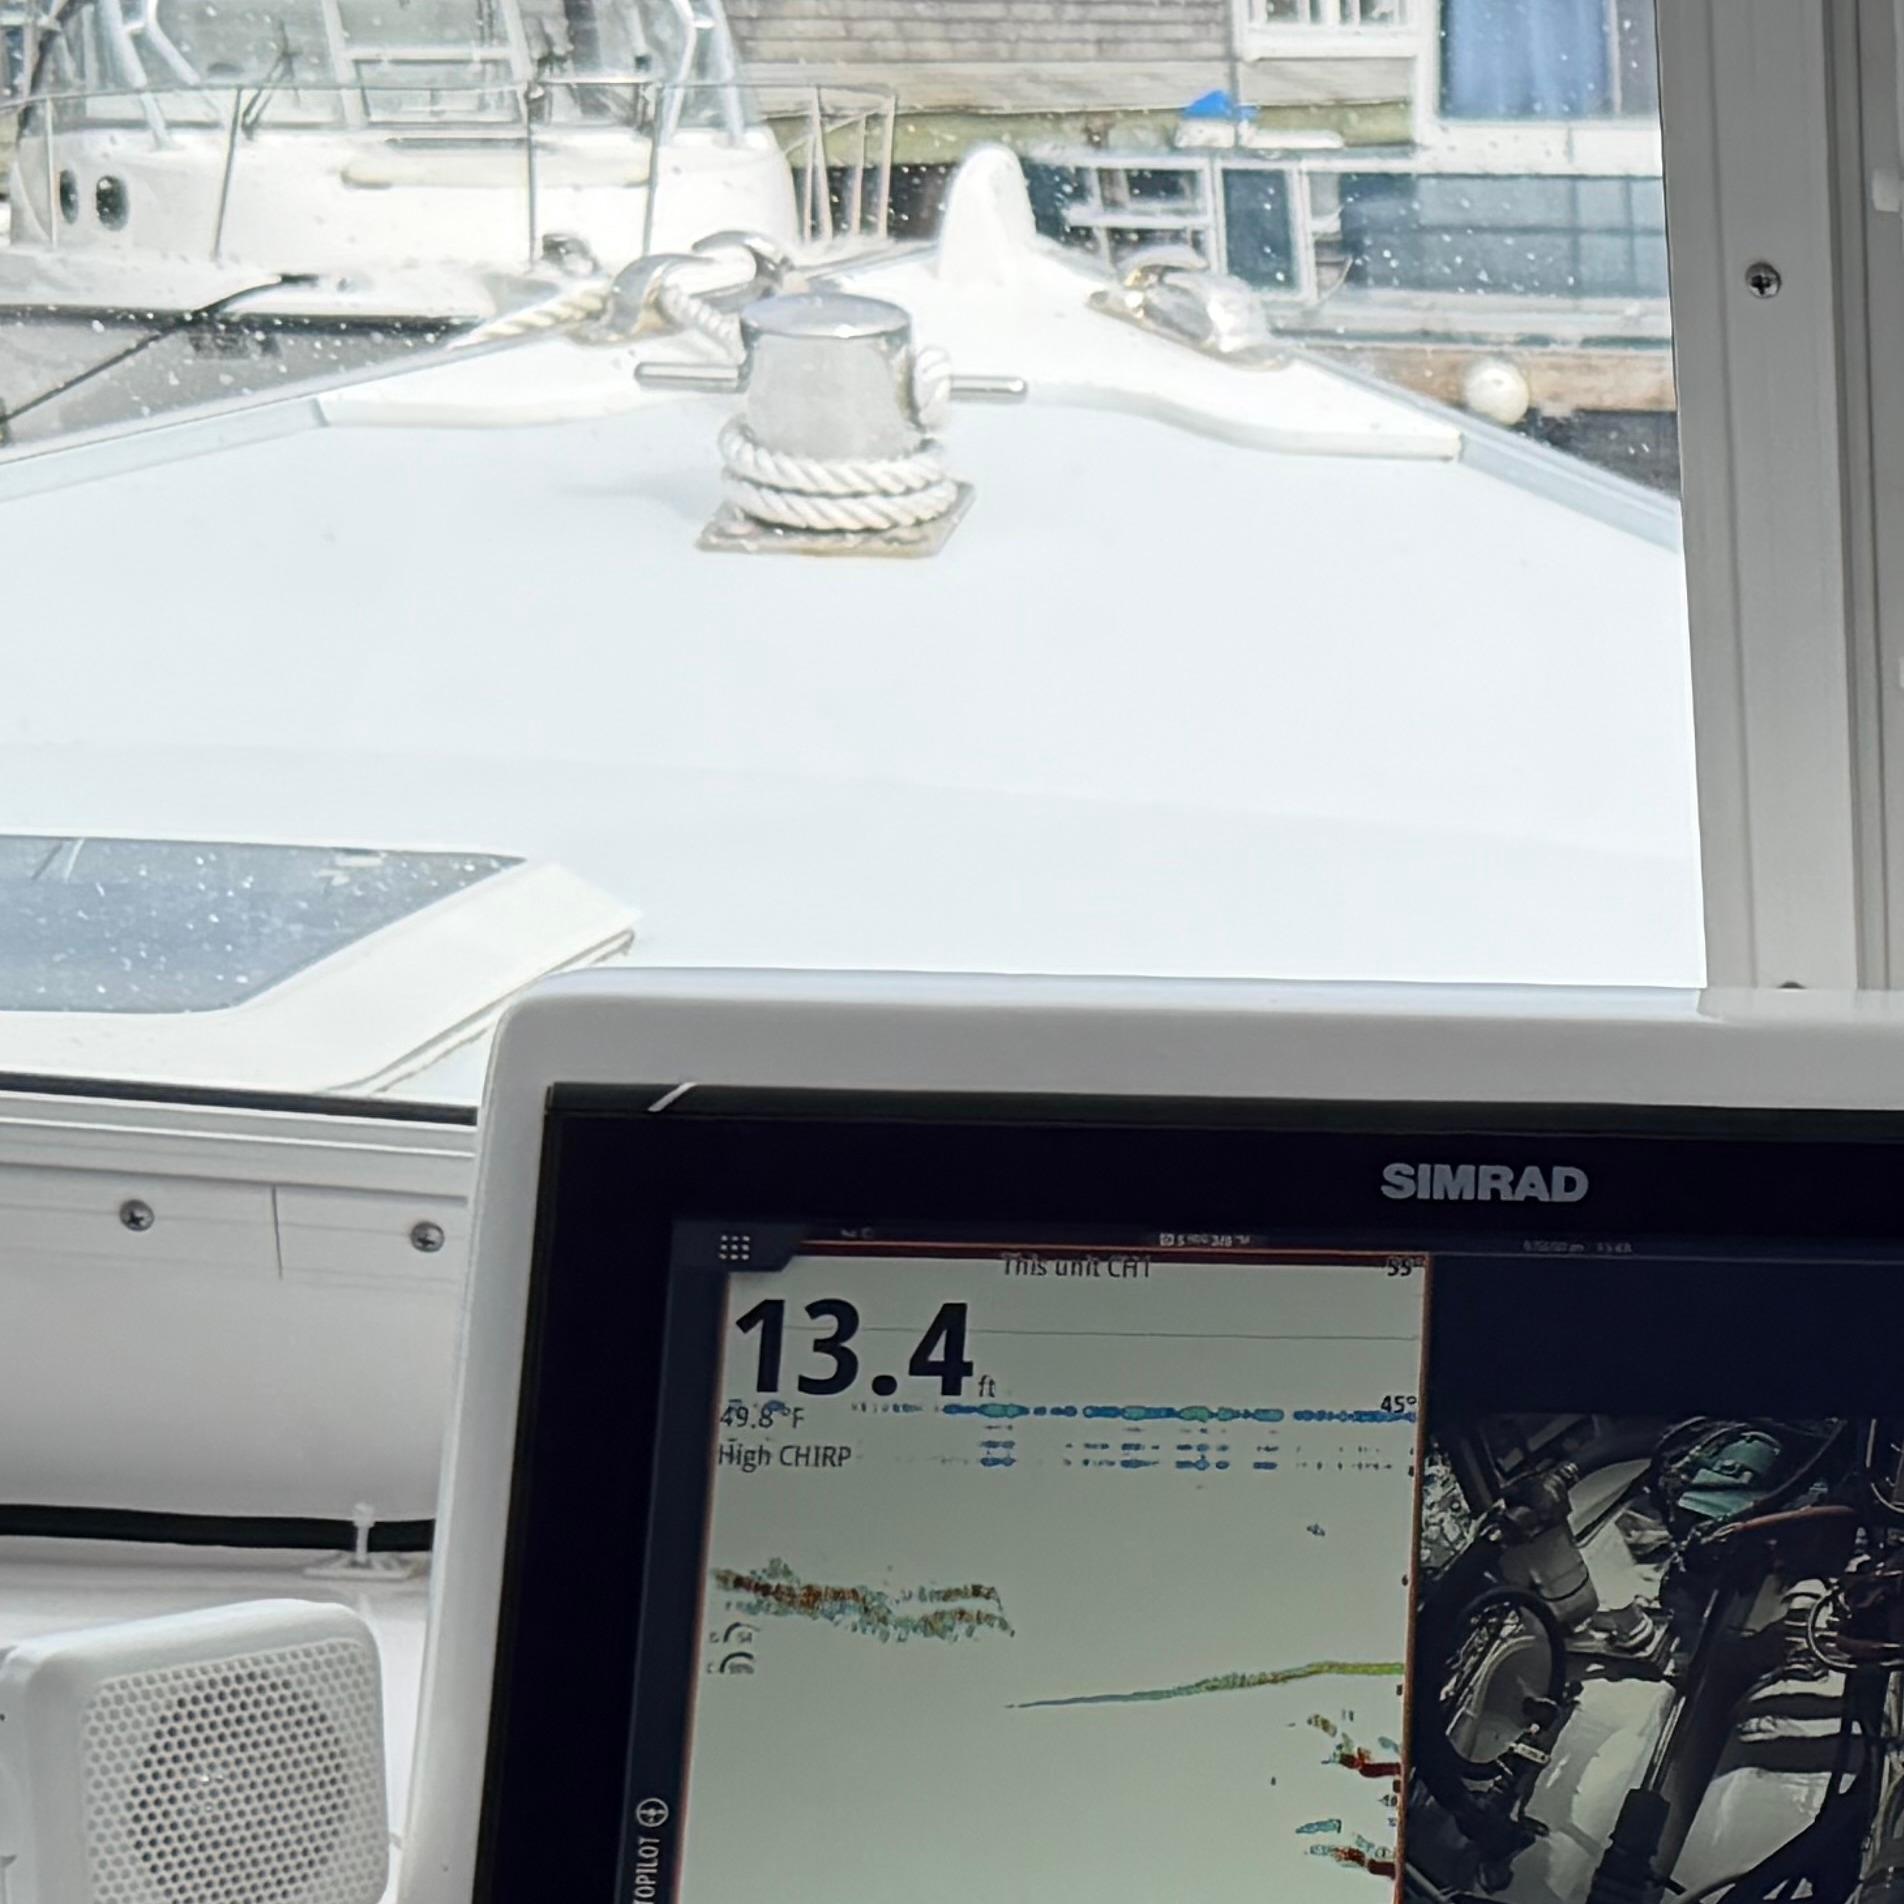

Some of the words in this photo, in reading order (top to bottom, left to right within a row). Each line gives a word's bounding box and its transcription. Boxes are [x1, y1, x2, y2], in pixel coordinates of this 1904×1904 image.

[1381, 1162, 1588, 1203] SIMRAD
[1003, 1256, 1047, 1277] This
[1055, 1258, 1100, 1278] unit
[735, 1298, 974, 1396] 13.4
[977, 1374, 996, 1398] ft
[1381, 1395, 1417, 1414] 45°
[718, 1443, 771, 1473] High
[779, 1444, 852, 1469] CHIRP
